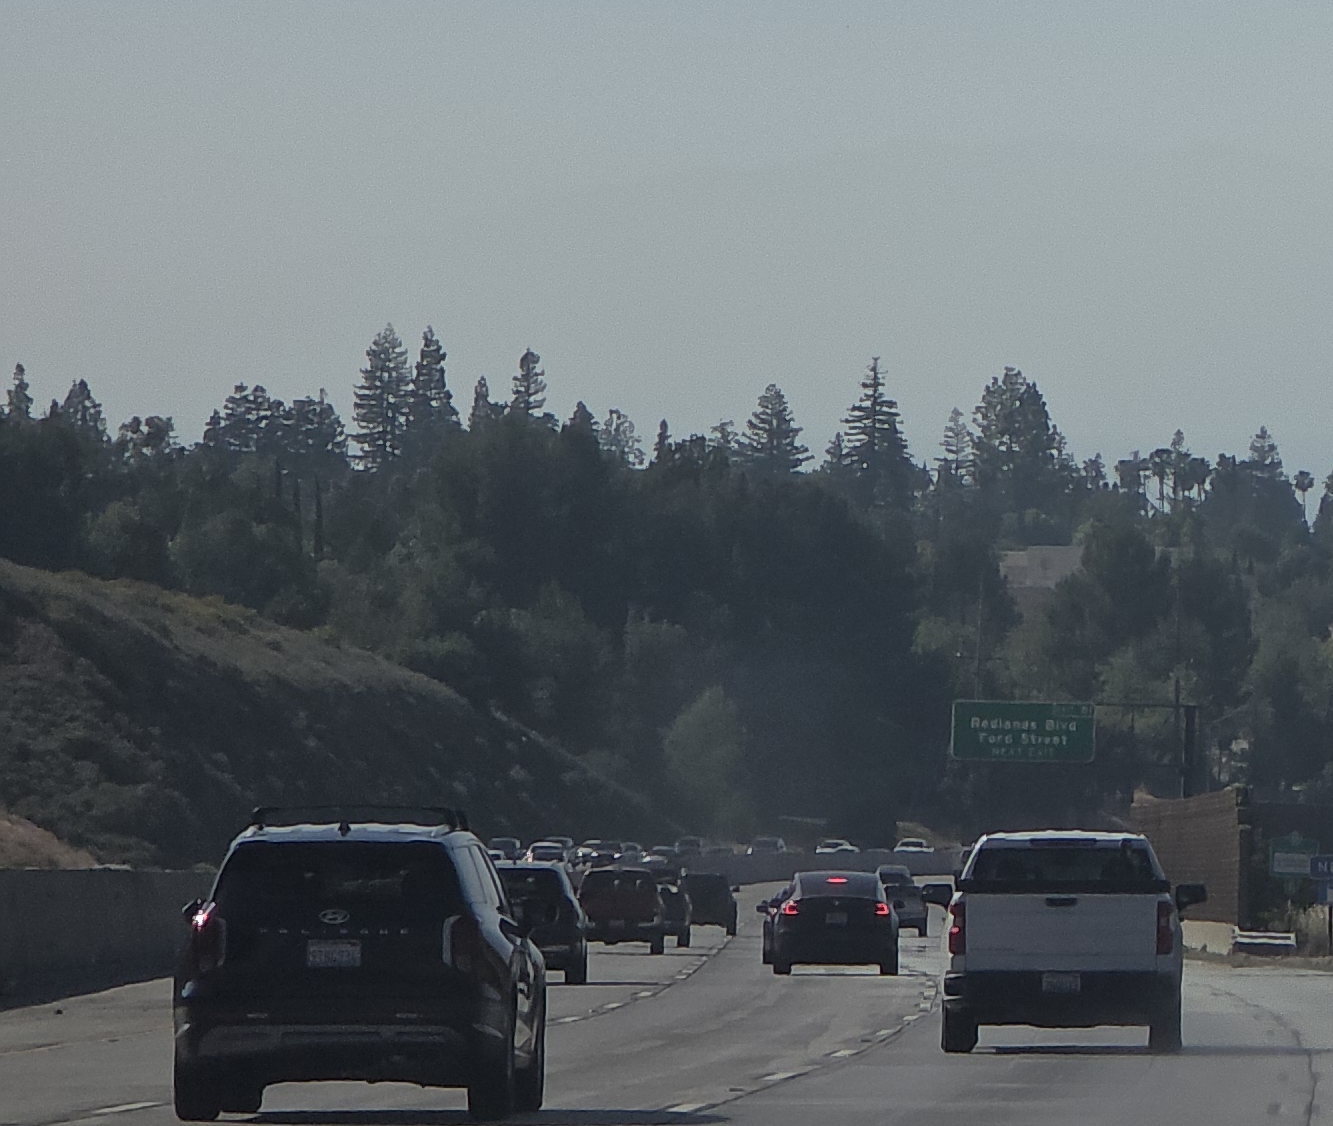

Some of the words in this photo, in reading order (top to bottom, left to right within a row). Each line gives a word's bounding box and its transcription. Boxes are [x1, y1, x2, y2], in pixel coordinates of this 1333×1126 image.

[970, 717, 1038, 730] Redlands
[1045, 718, 1077, 731] Blvd
[978, 732, 1013, 744] Ford
[1021, 733, 1068, 745] Street
